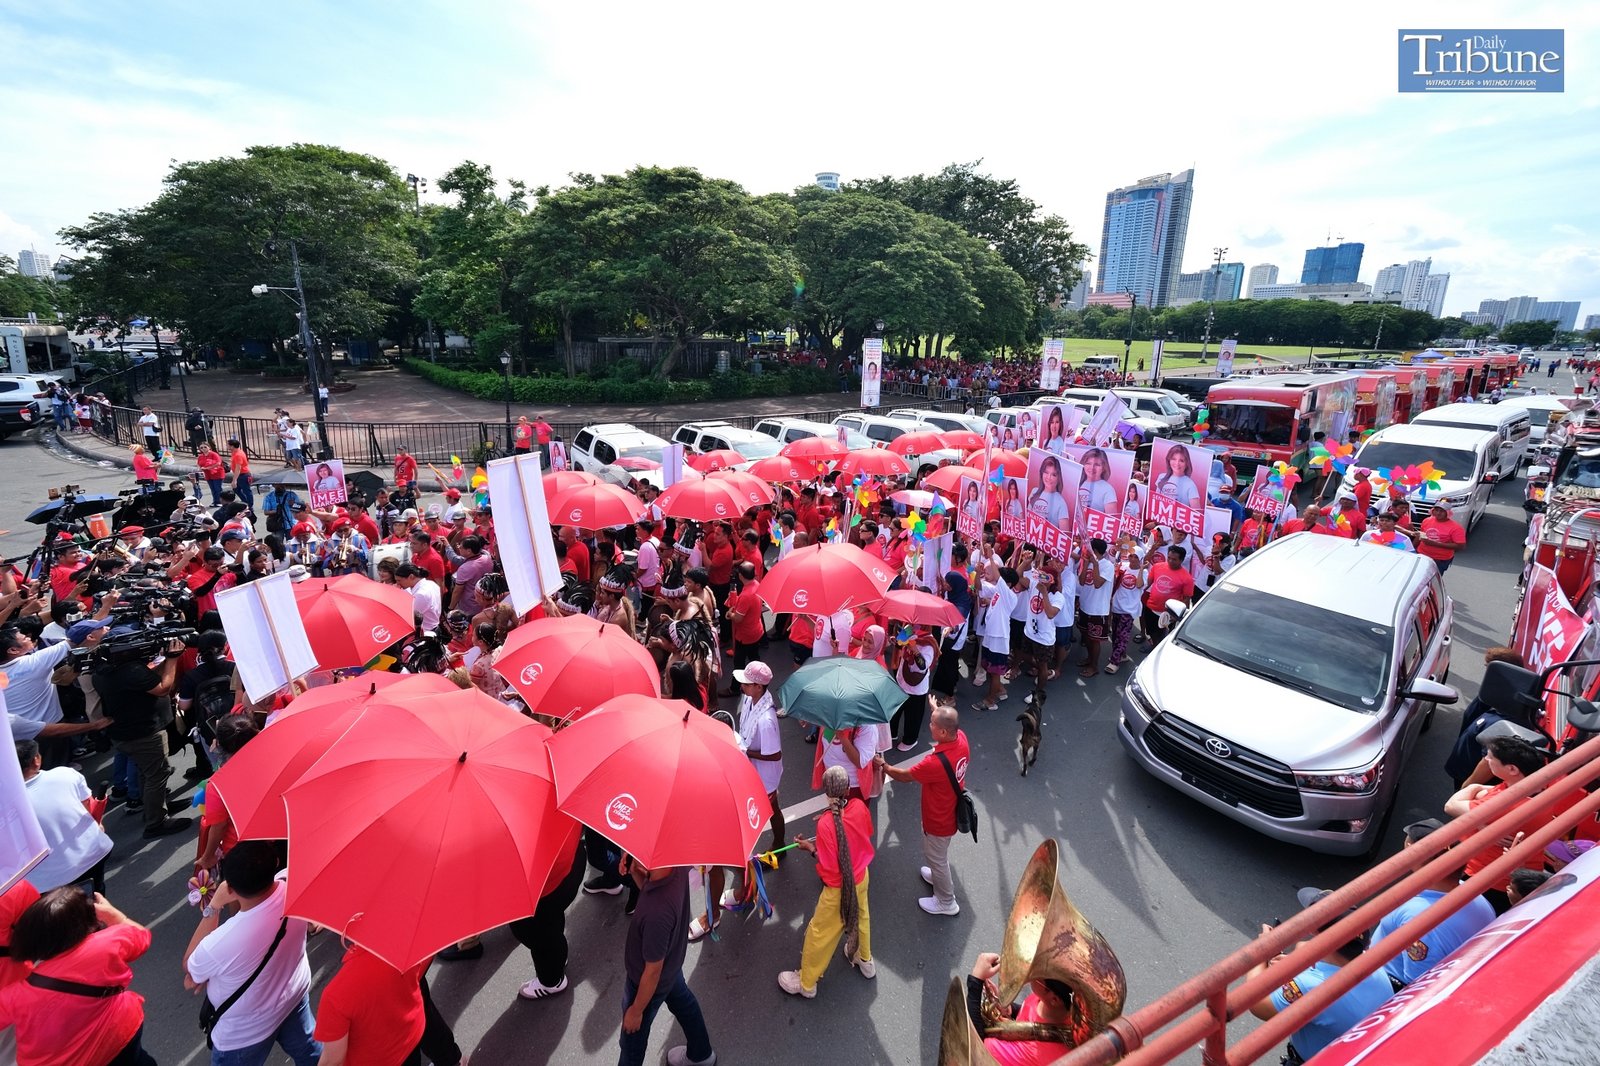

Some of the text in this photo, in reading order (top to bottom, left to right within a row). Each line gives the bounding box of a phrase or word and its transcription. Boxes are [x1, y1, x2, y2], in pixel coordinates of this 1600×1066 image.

[312, 488, 345, 504] IMEE
[313, 498, 345, 508] MARCOS
[1152, 494, 1176, 505] SENATOR
[1250, 495, 1284, 512] IMEE
[1151, 498, 1201, 528] IMEE
[959, 515, 978, 534] IME
[1087, 513, 1116, 534] EE
[1150, 512, 1200, 536] MARCOS
[1029, 518, 1068, 554] MEE
